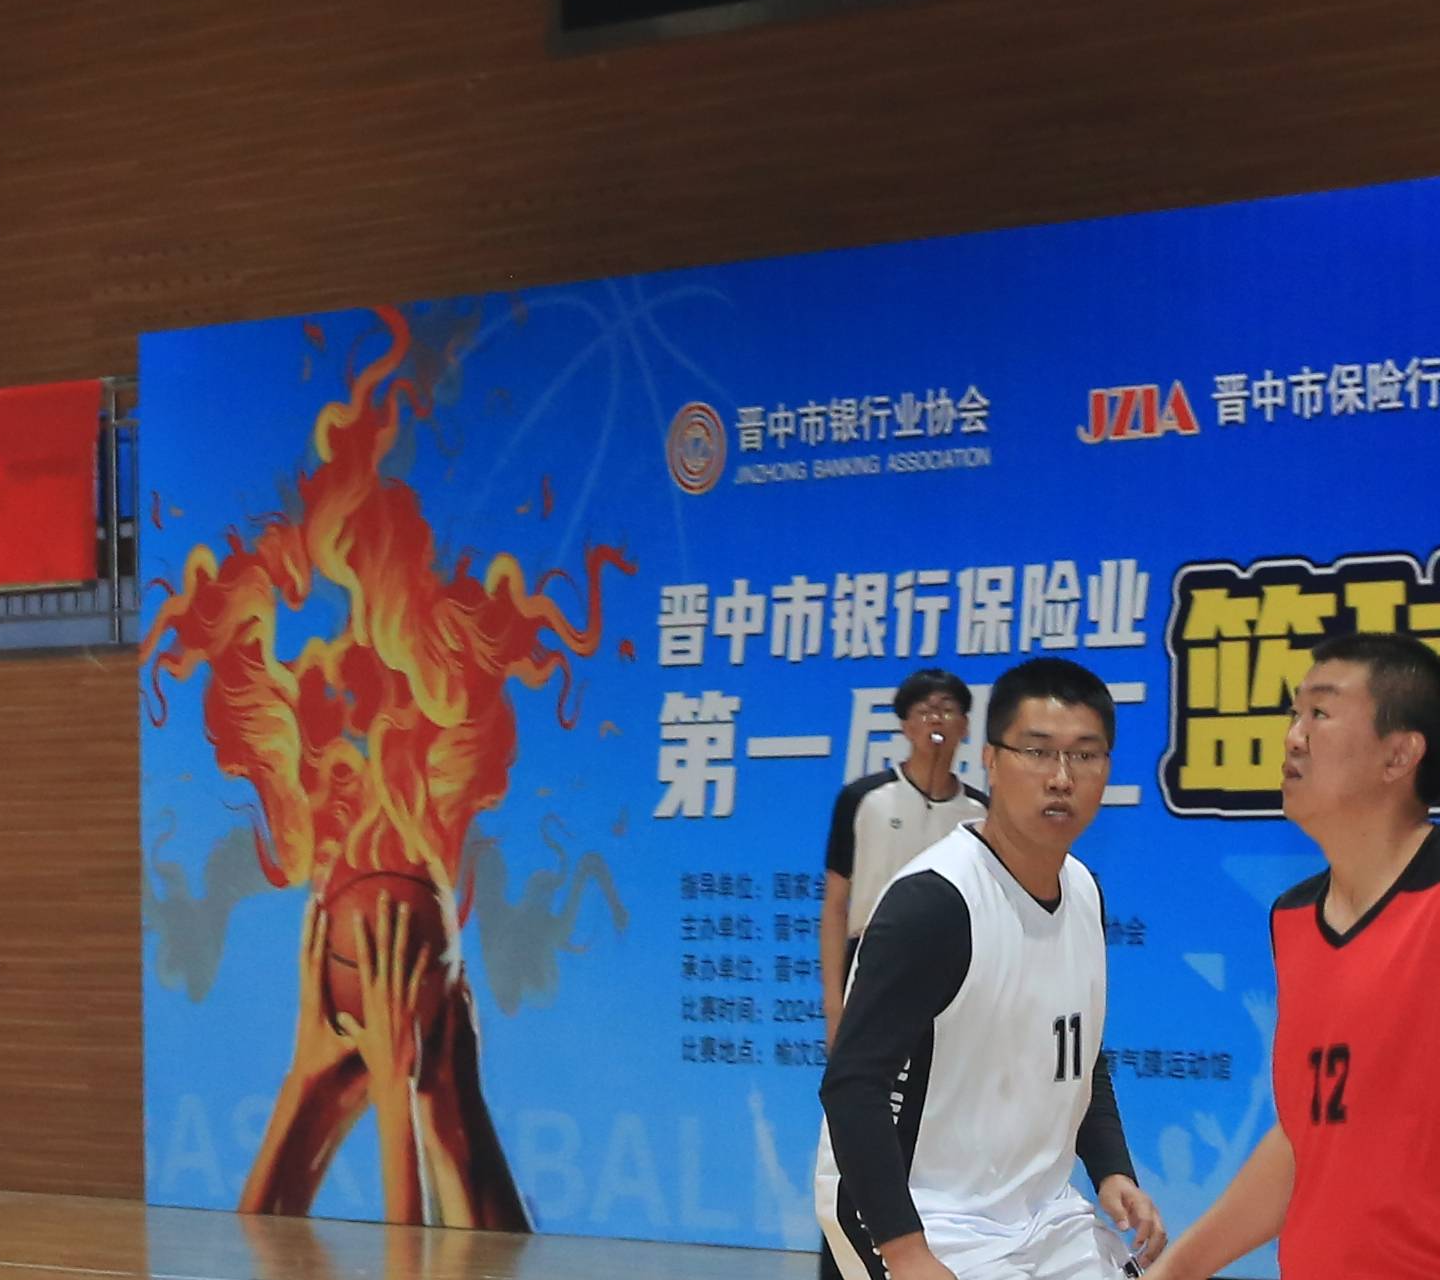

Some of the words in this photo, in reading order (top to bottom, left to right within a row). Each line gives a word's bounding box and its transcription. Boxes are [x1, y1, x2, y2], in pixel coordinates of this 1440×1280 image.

[736, 384, 991, 452] 晋中市银行业协会
[1077, 381, 1200, 444] JZIA
[657, 559, 1150, 667] 晋中市银行保险业
[1052, 1011, 1082, 1083] 11
[1307, 1043, 1351, 1125] 12
